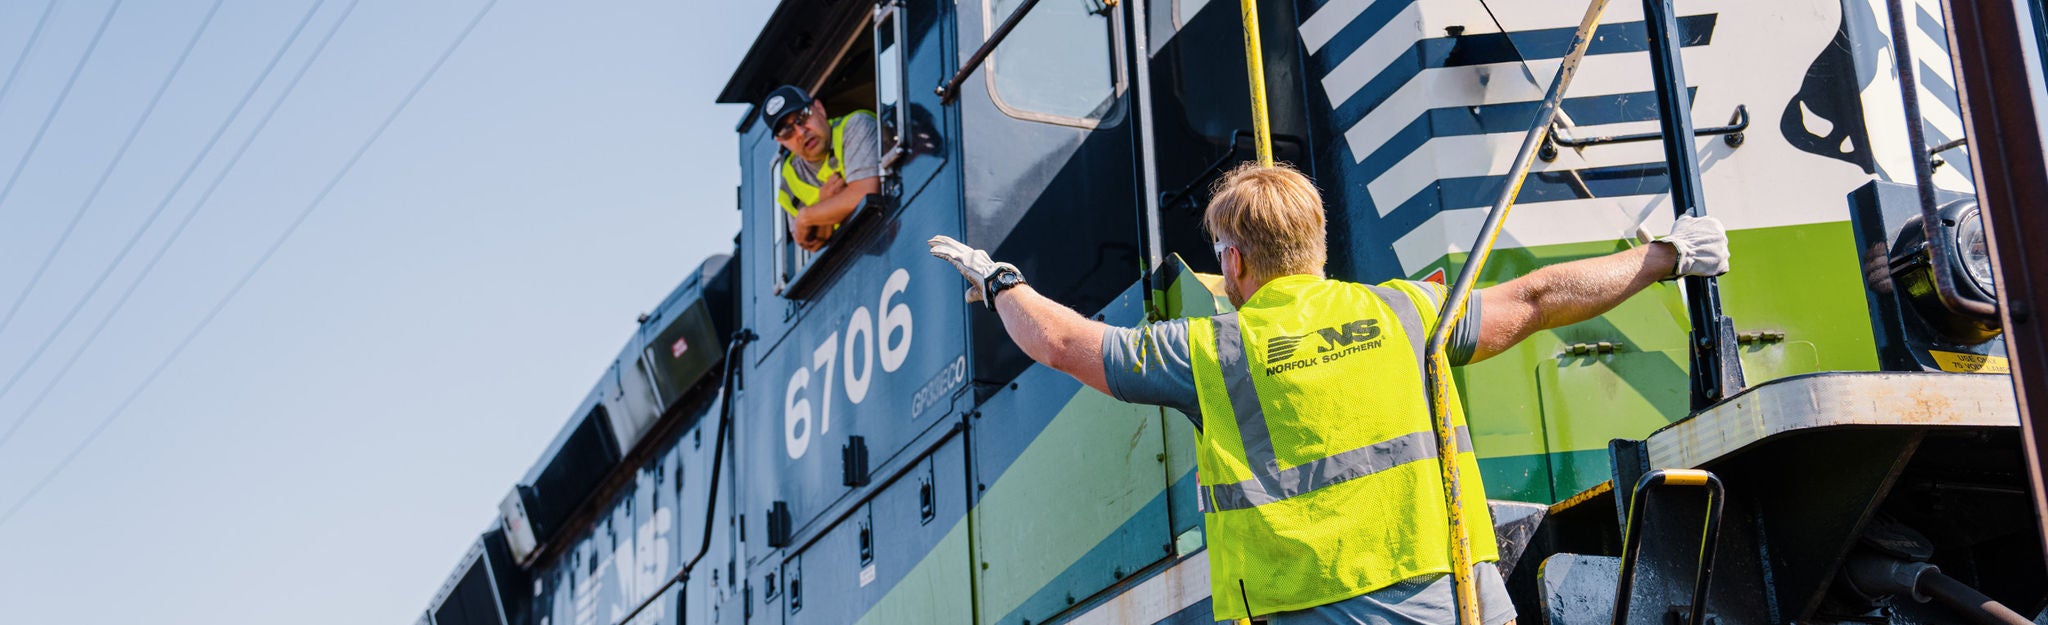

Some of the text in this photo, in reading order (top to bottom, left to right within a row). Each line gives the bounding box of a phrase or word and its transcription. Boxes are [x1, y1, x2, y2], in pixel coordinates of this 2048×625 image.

[1317, 318, 1381, 353] NS
[785, 268, 913, 460] 6706
[1266, 339, 1382, 376] NORFOLK SOUTHERN
